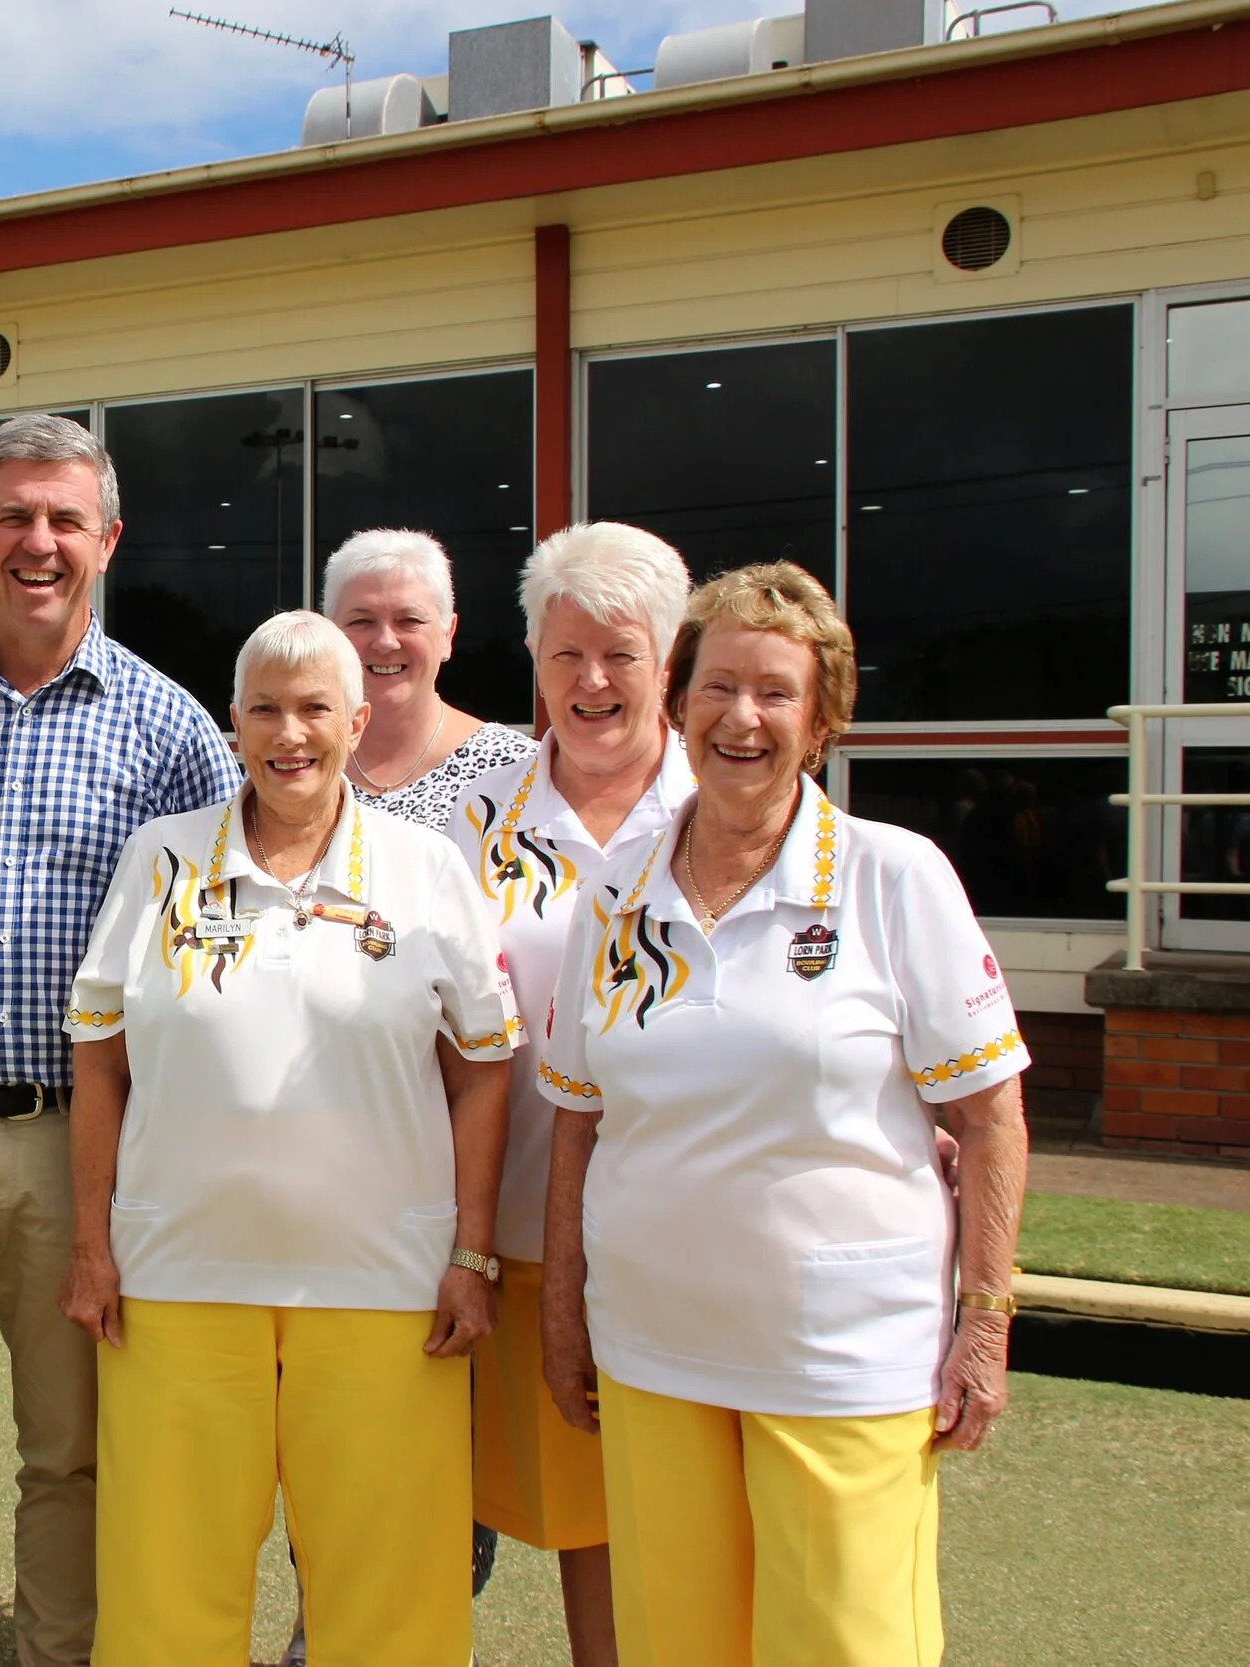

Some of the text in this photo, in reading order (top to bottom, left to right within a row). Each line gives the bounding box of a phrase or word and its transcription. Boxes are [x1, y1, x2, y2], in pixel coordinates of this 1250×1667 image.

[204, 923, 242, 934] MARILYN
[794, 943, 834, 956] LORN PARK
